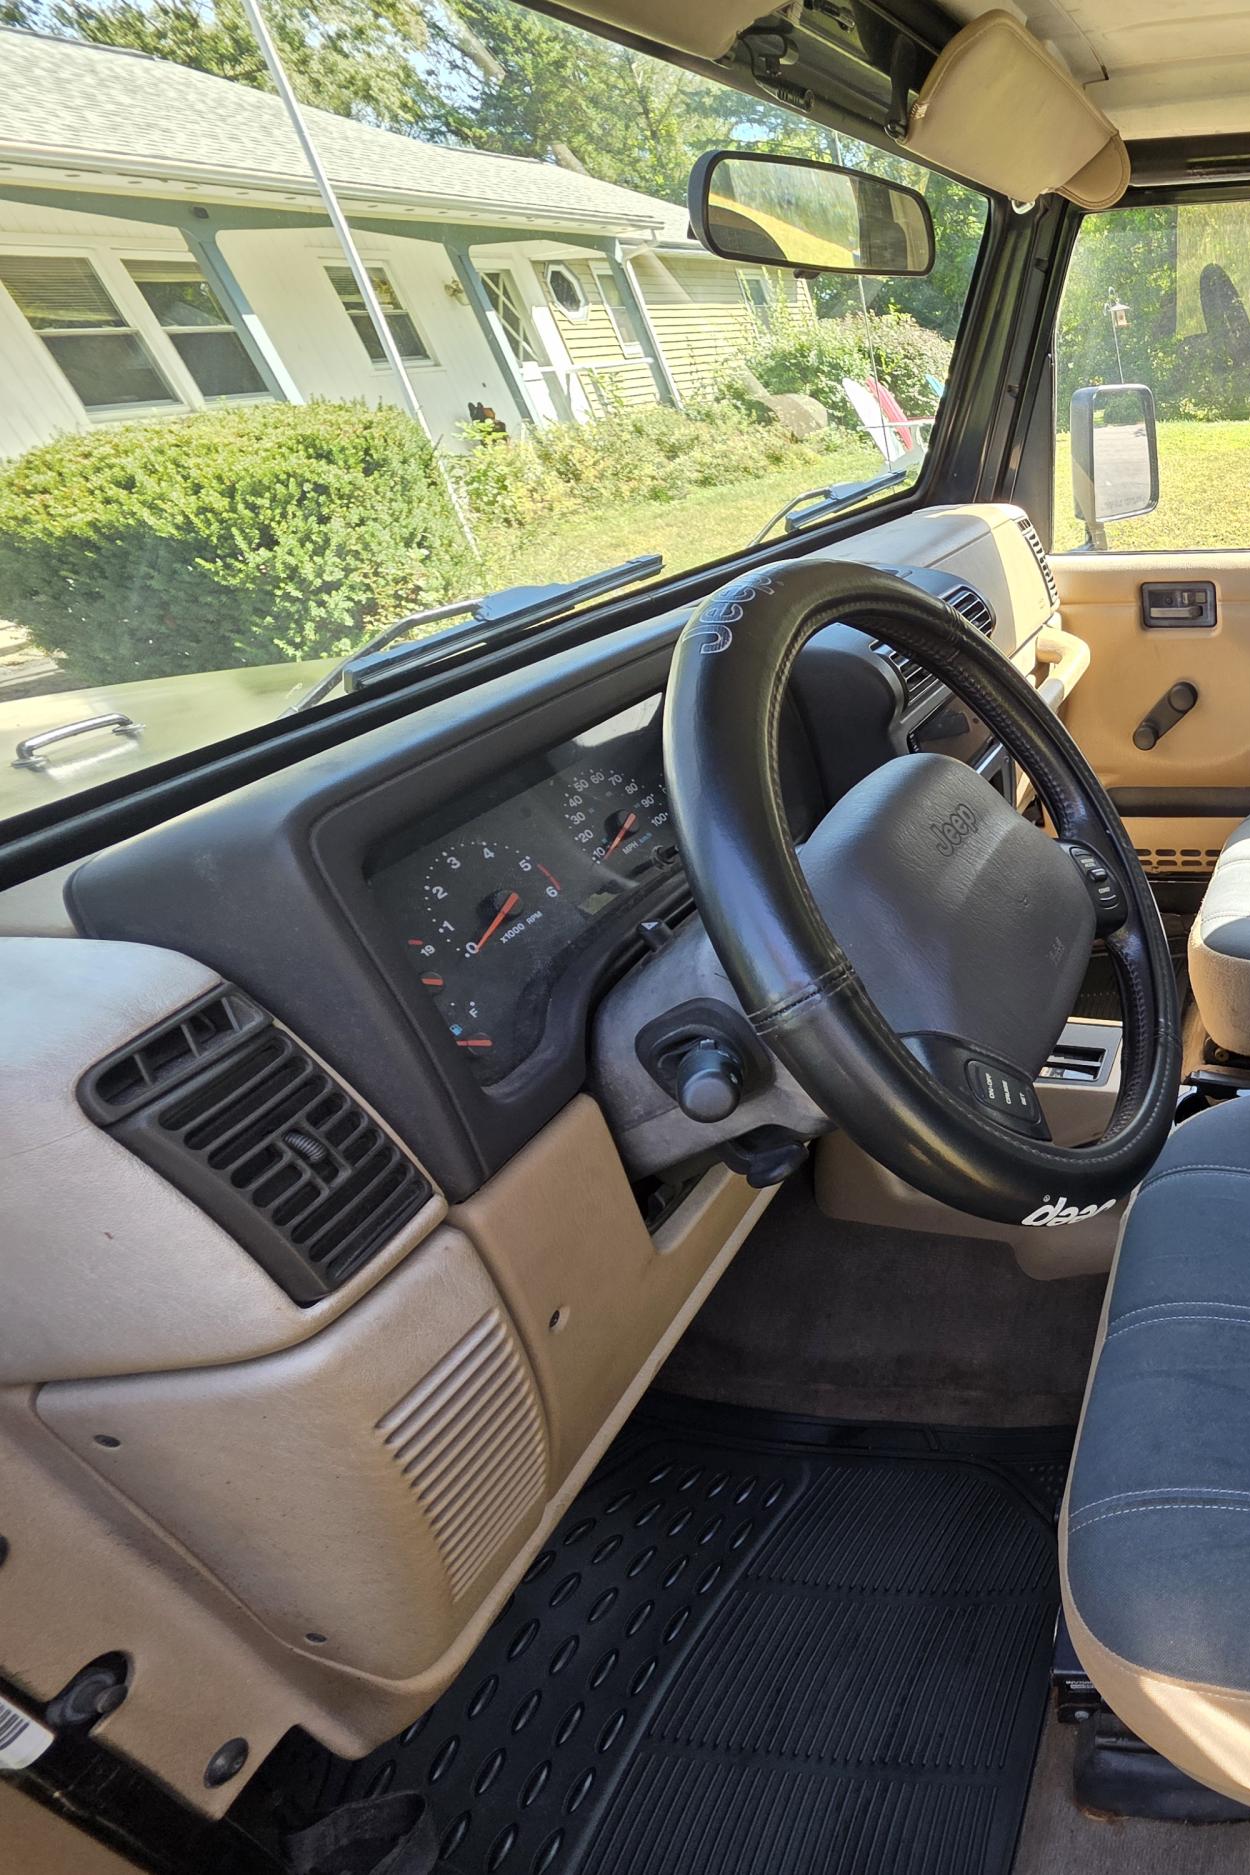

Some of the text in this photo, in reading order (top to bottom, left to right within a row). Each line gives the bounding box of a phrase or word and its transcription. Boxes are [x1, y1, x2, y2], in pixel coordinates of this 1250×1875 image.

[590, 772, 605, 784] 60
[608, 774, 623, 786] 70
[573, 779, 589, 792] 50
[625, 782, 639, 794] 80
[569, 795, 583, 808] 40
[641, 795, 655, 808] 90
[570, 811, 586, 825] 30
[651, 812, 668, 827] 100
[578, 829, 594, 843] 20
[930, 803, 979, 857] Jeep
[483, 847, 495, 859] 4
[593, 846, 606, 858] 10
[622, 840, 639, 855] MPH
[446, 856, 461, 869] 3
[519, 859, 532, 872] 5
[432, 886, 448, 900] 2
[545, 886, 558, 898] 6
[442, 920, 455, 932] 1
[500, 910, 543, 944] x1000 RPM
[420, 944, 436, 957] 19
[465, 942, 479, 954] 0
[469, 1008, 479, 1018] F
